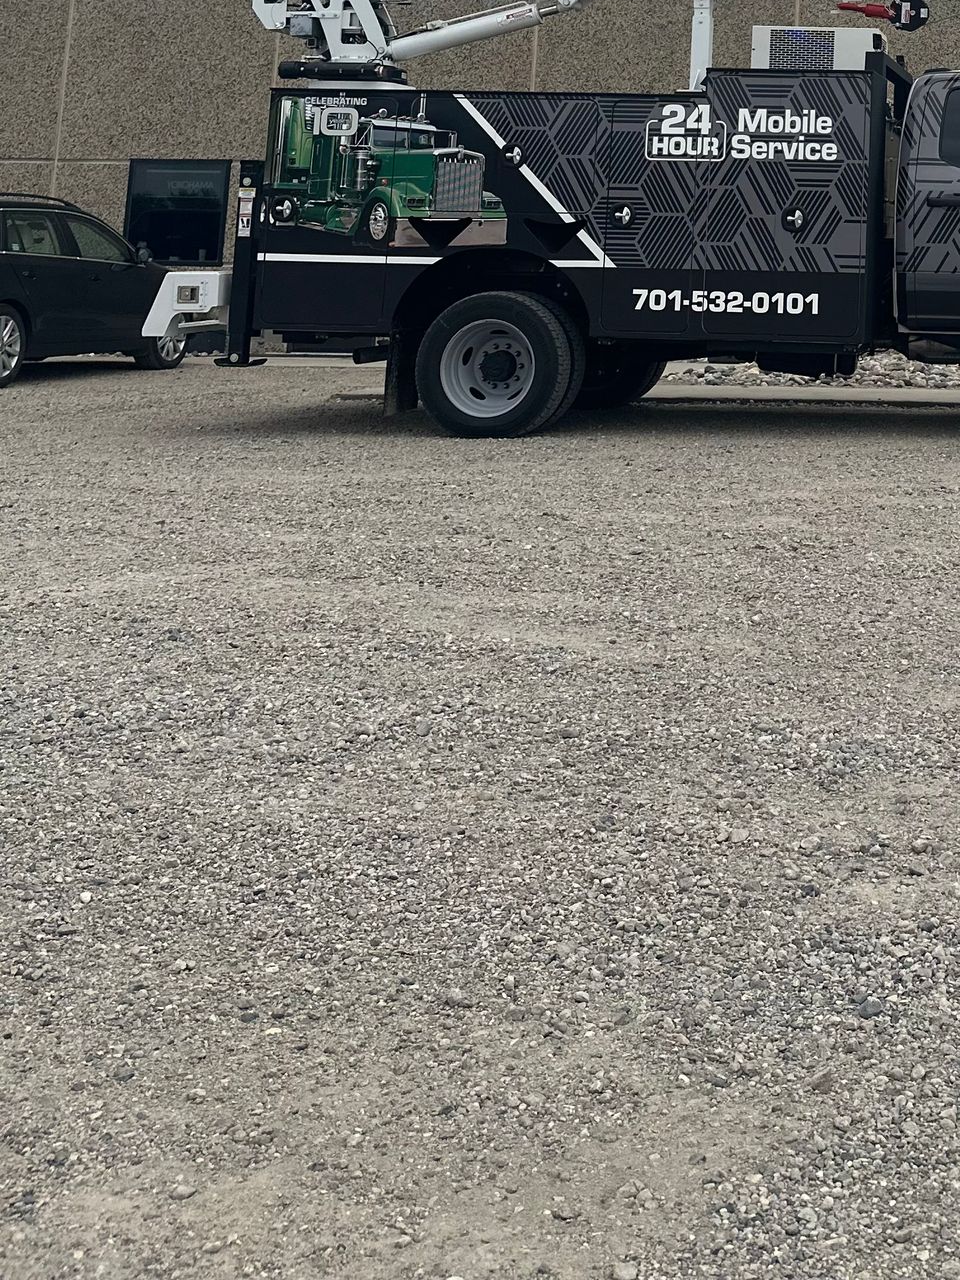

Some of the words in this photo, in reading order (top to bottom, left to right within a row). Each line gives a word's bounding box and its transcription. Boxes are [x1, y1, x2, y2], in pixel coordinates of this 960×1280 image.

[304, 96, 368, 106] CELEBRATING
[311, 106, 359, 136] 10
[661, 104, 712, 135] 24
[738, 108, 833, 134] Mobile
[652, 136, 719, 156] HOUR
[731, 135, 838, 161] Service
[632, 288, 820, 315] 701-532-0101
